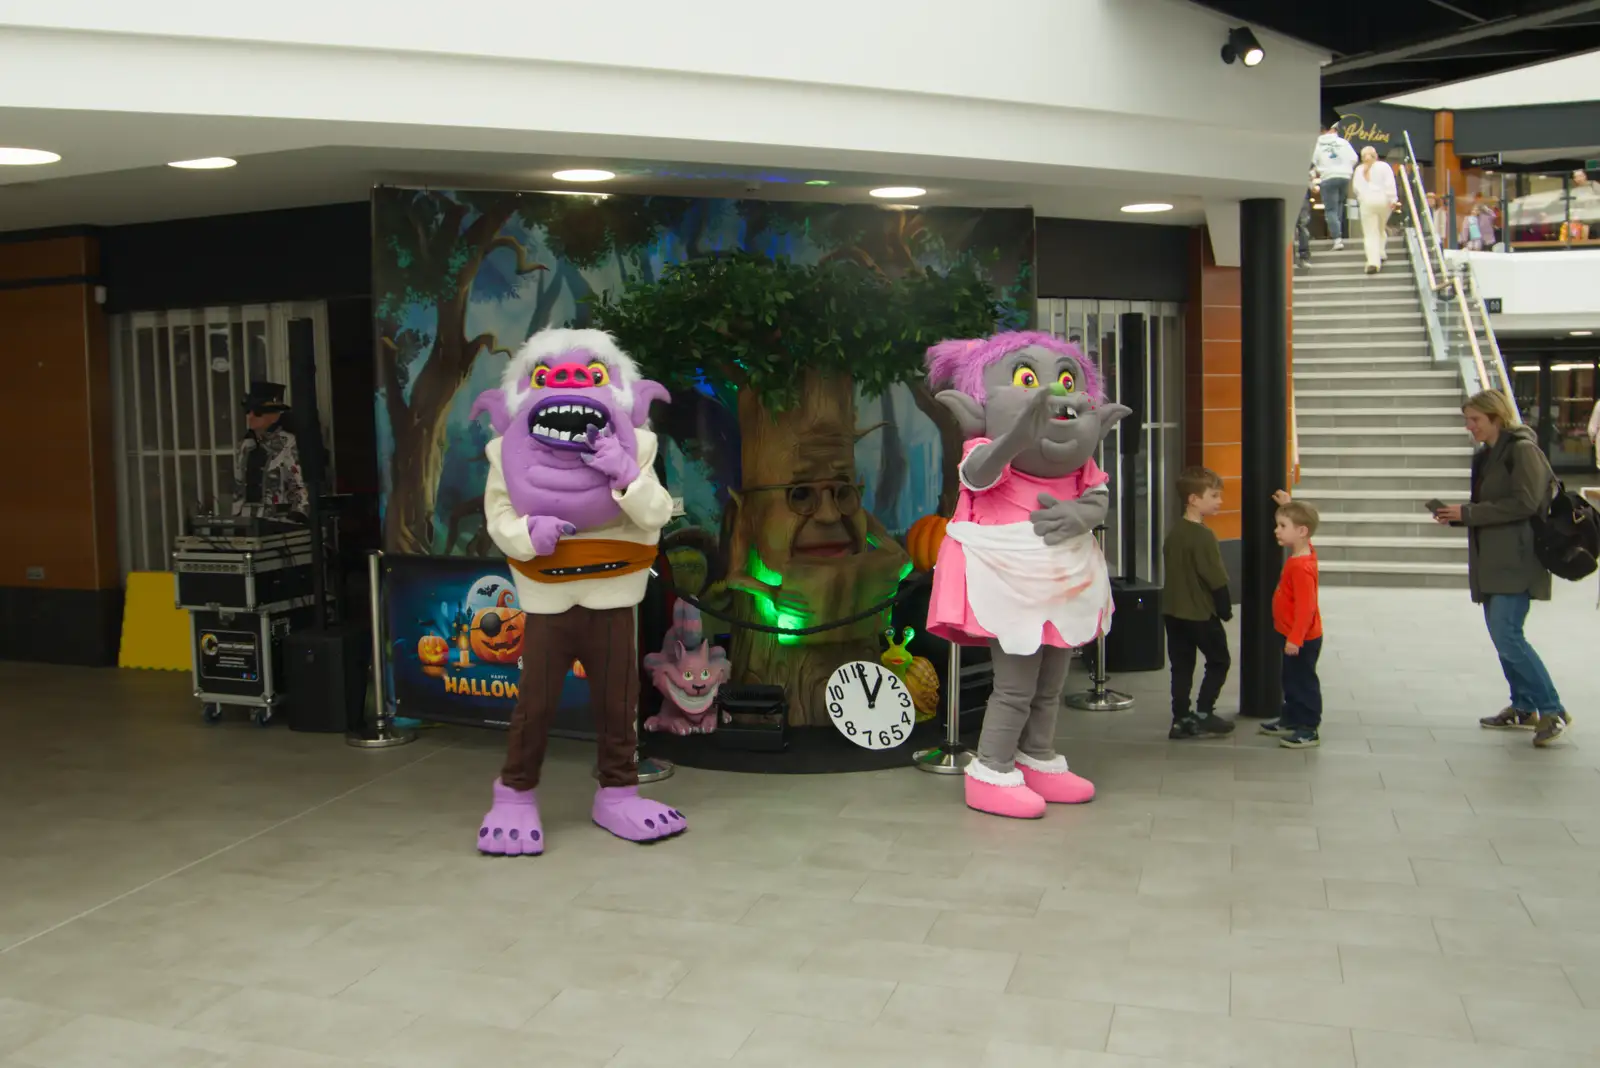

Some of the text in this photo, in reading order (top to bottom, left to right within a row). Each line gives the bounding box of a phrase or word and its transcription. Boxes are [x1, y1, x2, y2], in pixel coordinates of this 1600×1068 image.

[1340, 113, 1390, 143] Perkins
[838, 668, 850, 684] 11
[887, 675, 900, 690] 2
[828, 684, 845, 701] 10
[897, 692, 911, 708] 3
[829, 702, 844, 719] 9
[901, 711, 911, 726] 4
[844, 721, 857, 736] 8
[890, 724, 904, 740] 5
[862, 730, 873, 746] 7
[878, 730, 891, 746] 6
